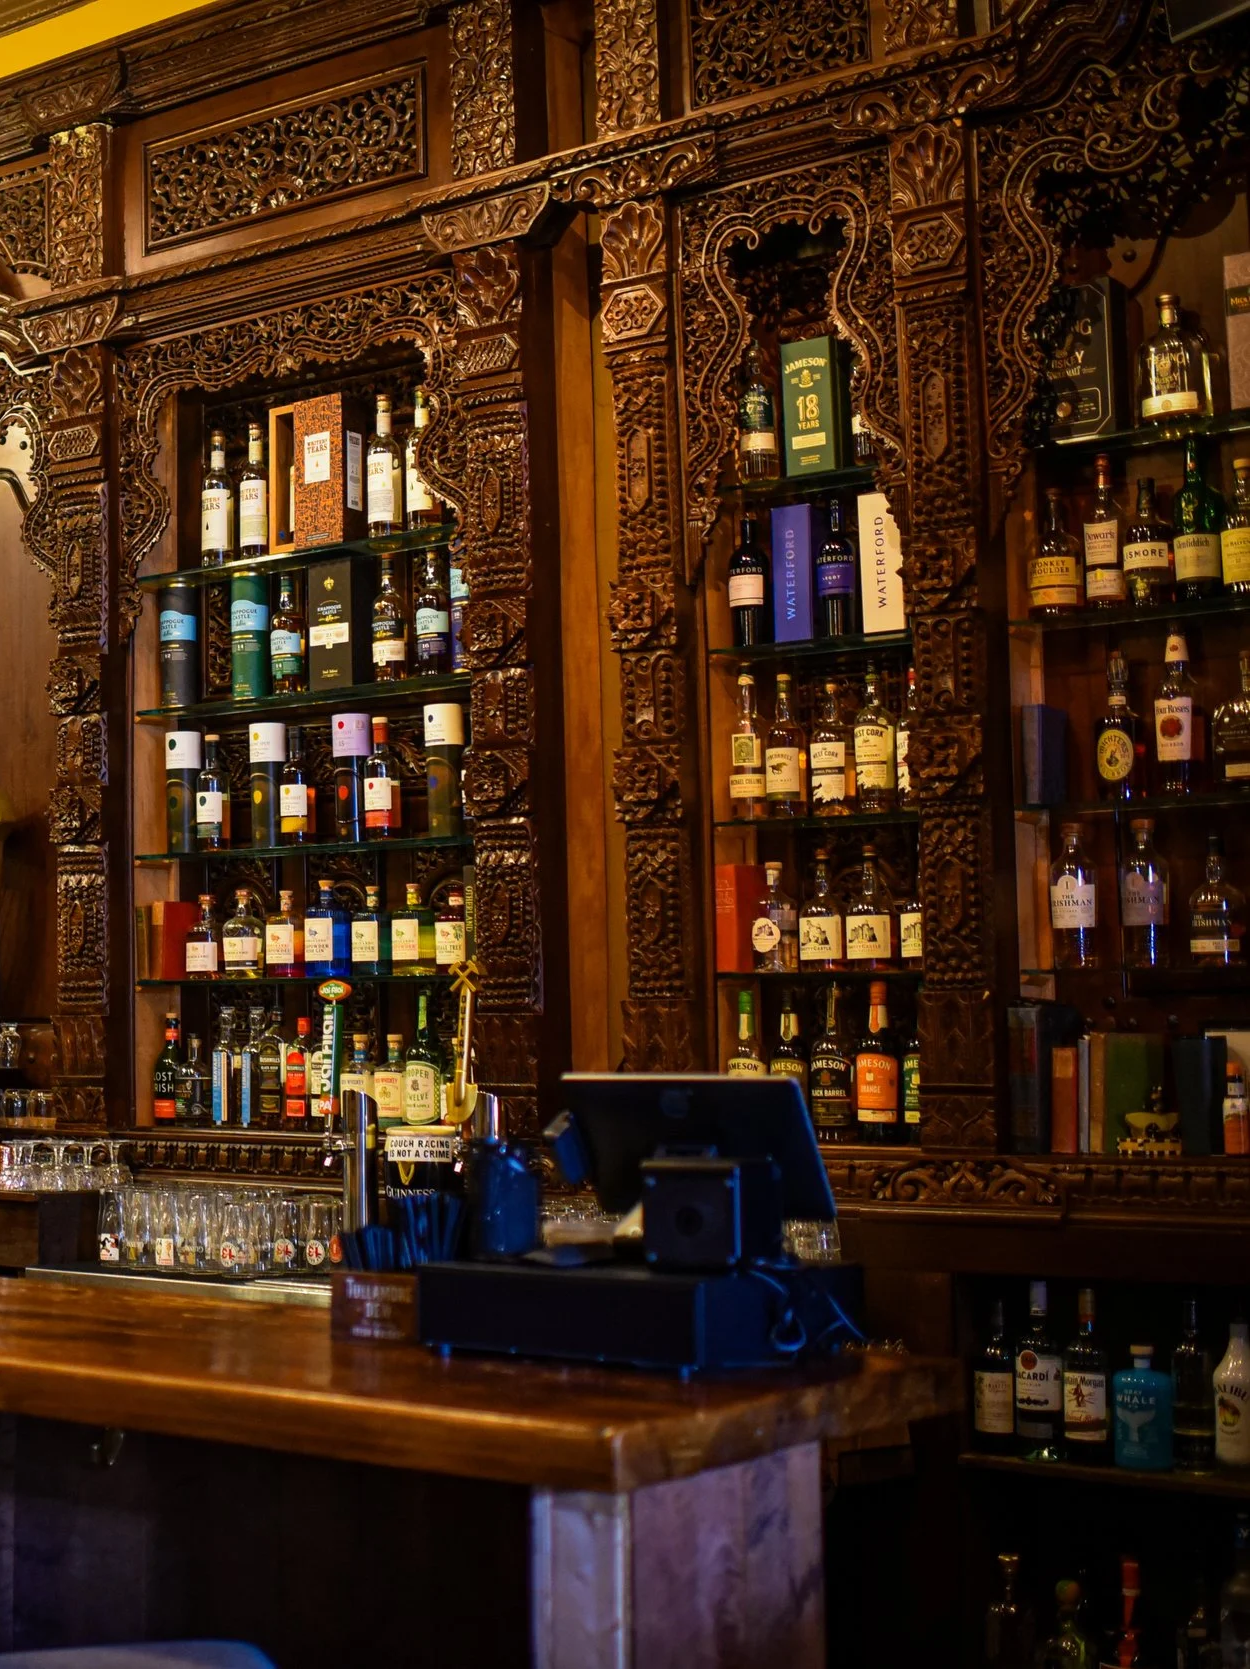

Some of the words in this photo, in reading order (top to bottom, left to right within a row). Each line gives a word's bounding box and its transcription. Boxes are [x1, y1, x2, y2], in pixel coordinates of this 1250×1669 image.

[784, 357, 826, 374] JAMESON
[796, 393, 820, 421] 18
[798, 420, 820, 430] YEARS
[307, 444, 328, 454] TEARS
[874, 515, 887, 609] WATERFORD
[785, 529, 796, 620] WATERFORD
[465, 886, 473, 932] OTHERLAND
[811, 1060, 847, 1072] JAMESON
[390, 1139, 414, 1148] COUCH
[418, 1139, 450, 1149] RACING
[390, 1150, 395, 1158] IS
[397, 1150, 411, 1158] NOT
[415, 1150, 420, 1158] A
[424, 1150, 450, 1159] CRIME
[1116, 1394, 1156, 1405] WHALE
